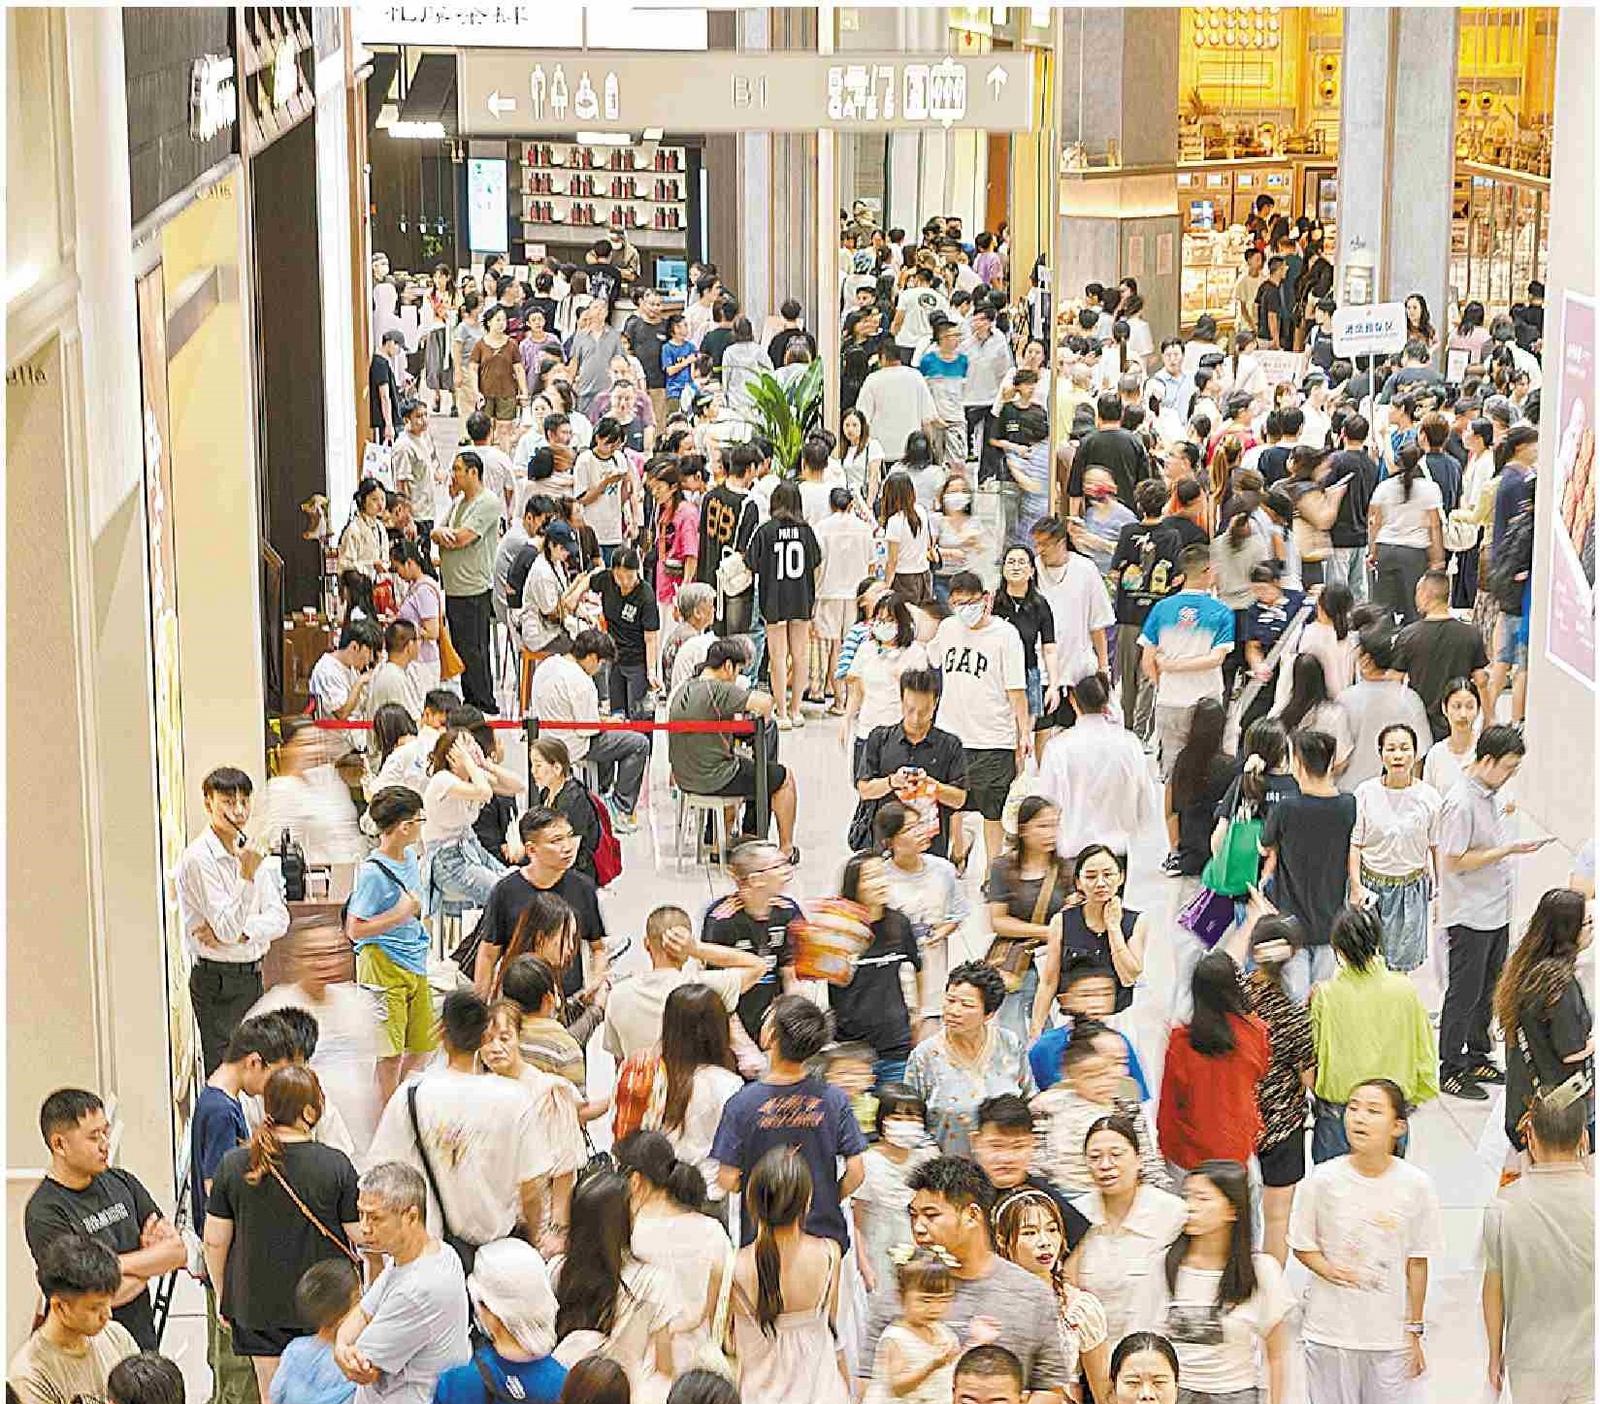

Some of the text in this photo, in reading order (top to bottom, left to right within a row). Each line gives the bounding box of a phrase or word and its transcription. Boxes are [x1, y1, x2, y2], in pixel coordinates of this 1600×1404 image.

[731, 72, 768, 110] B1
[773, 540, 805, 580] 10
[945, 646, 988, 679] GAP
